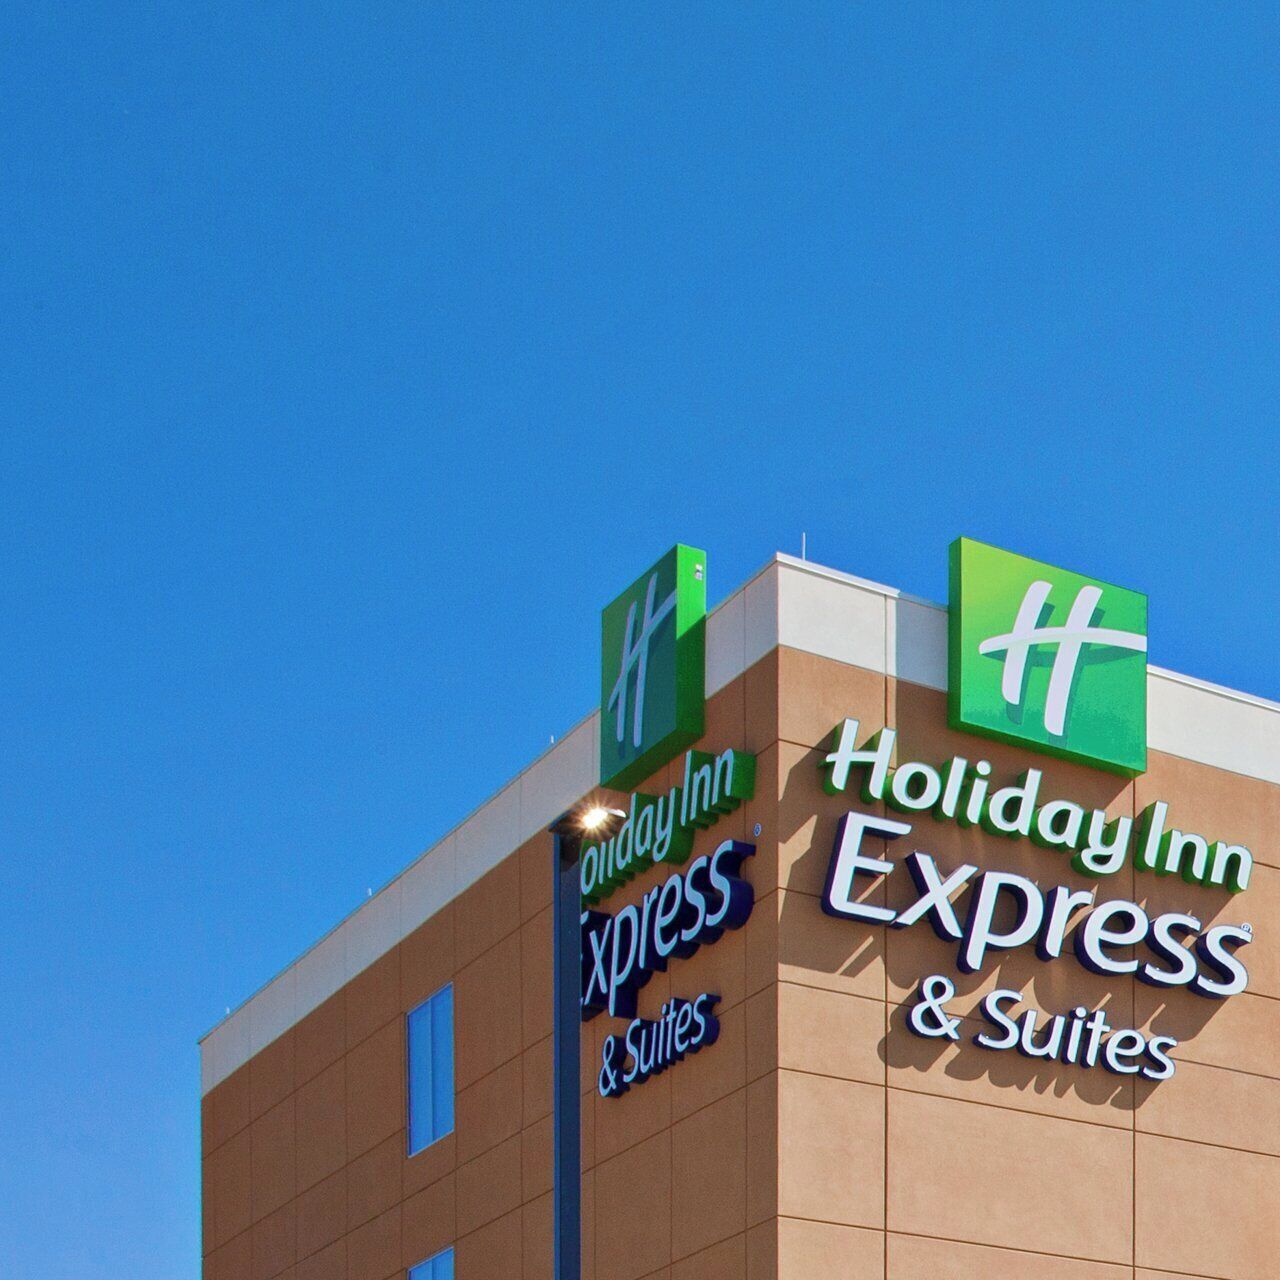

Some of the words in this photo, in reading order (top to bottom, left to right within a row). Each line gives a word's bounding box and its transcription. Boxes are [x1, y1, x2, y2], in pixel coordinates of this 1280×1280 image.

[580, 787, 676, 895] oliday
[680, 748, 735, 827] Inn
[825, 717, 1134, 875] Holiday
[1143, 800, 1254, 892] Inn
[580, 839, 735, 1018] xpress
[825, 810, 1254, 997] Express
[599, 1034, 618, 1099] &
[623, 993, 708, 1084] Suites
[909, 974, 963, 1041] &
[977, 988, 1178, 1081] Suites
